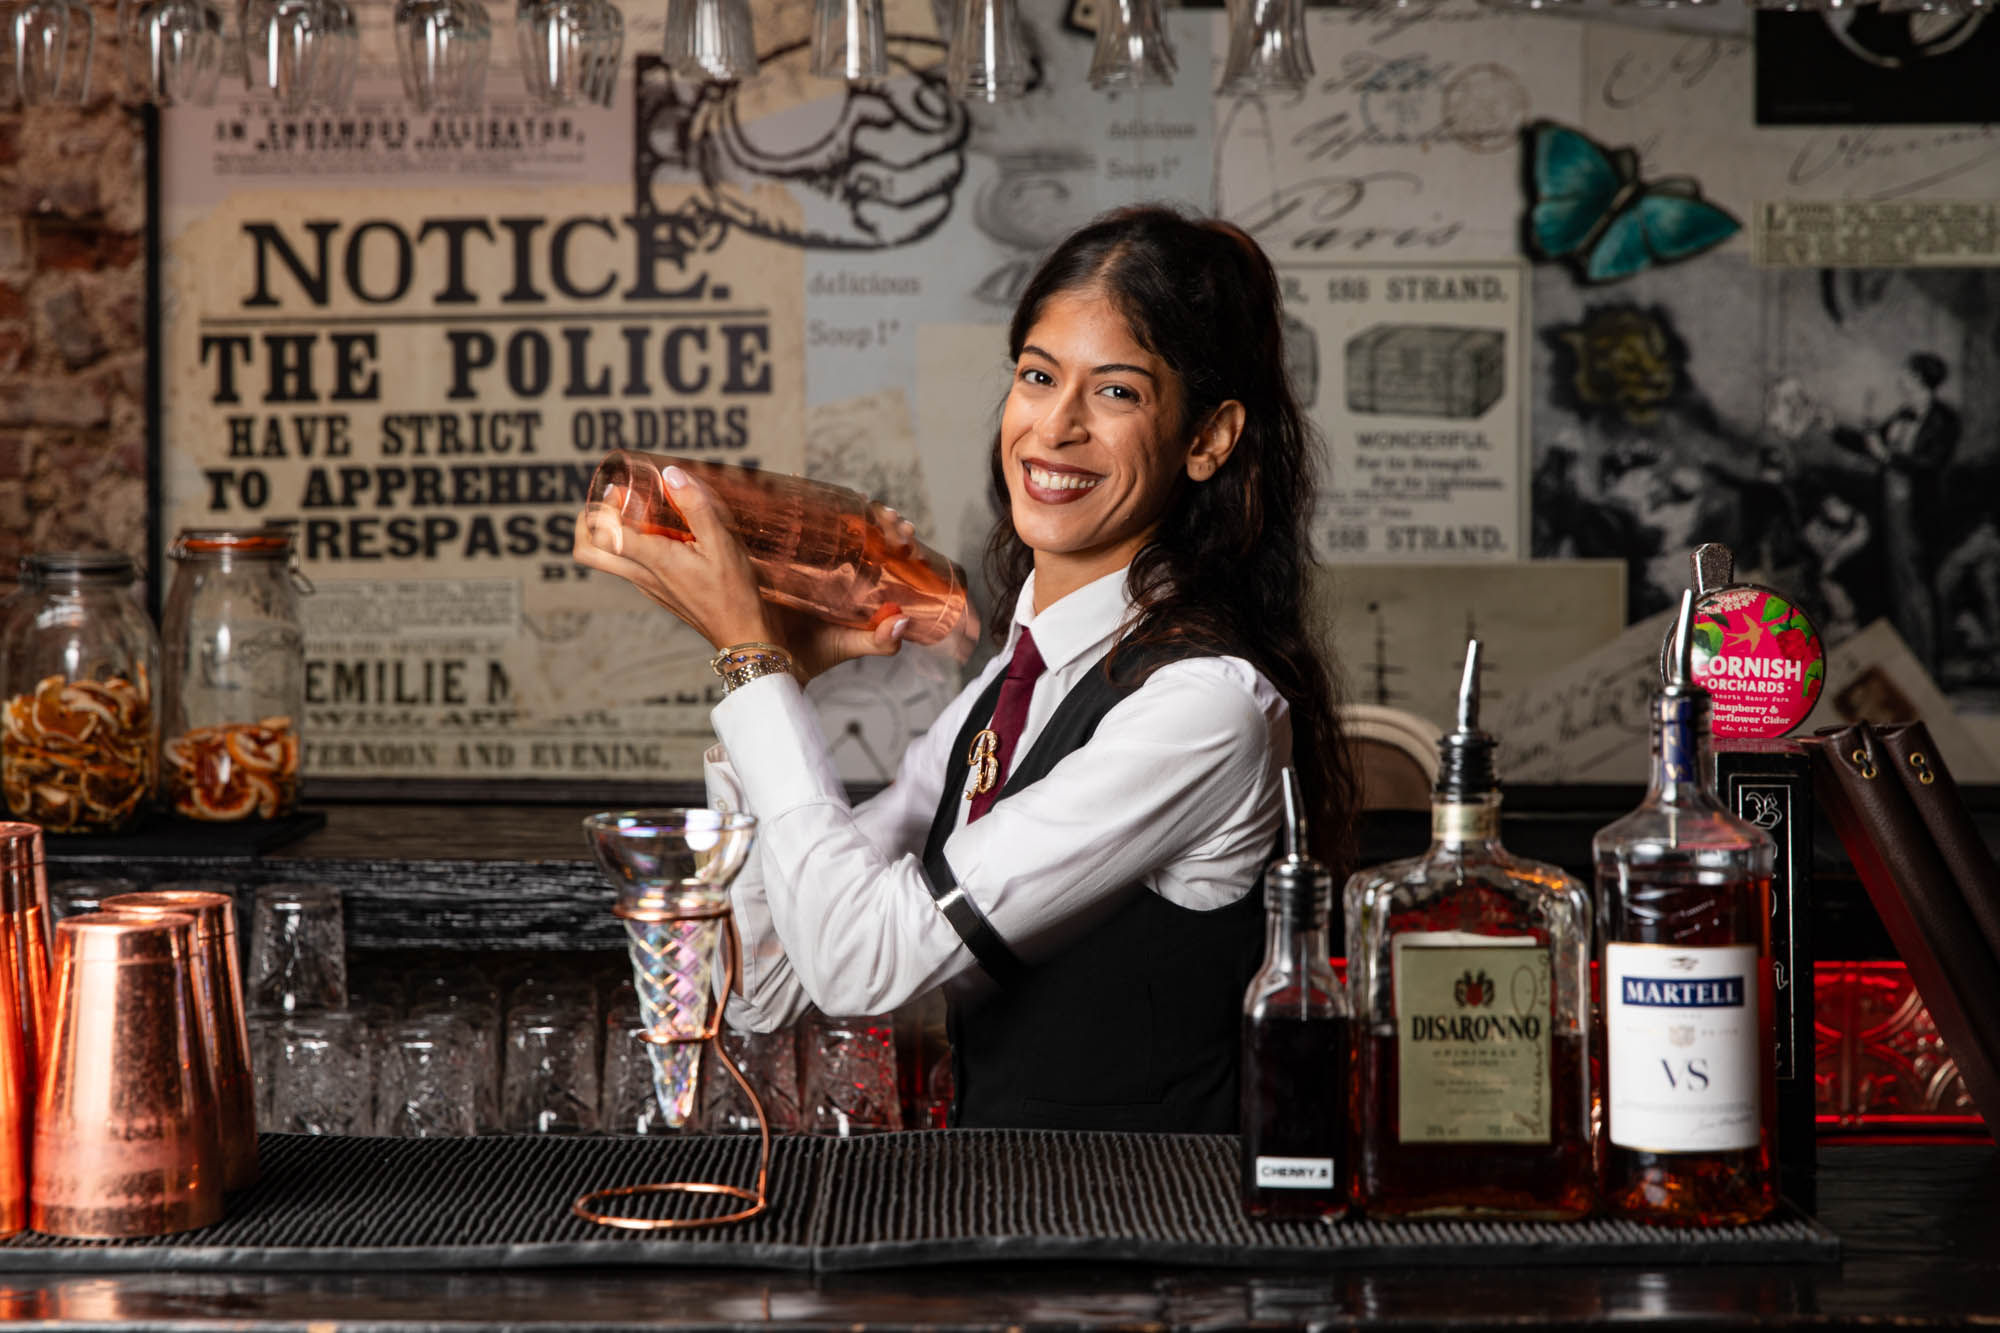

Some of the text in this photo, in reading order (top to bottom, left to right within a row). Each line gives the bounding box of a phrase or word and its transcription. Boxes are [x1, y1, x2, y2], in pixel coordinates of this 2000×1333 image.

[1108, 119, 1196, 140] delicious
[241, 215, 732, 306] NOTICE.
[806, 268, 923, 297] delicious
[1386, 275, 1510, 304] STRAND.
[200, 323, 773, 403] THE POLICE
[228, 407, 748, 458] HAVE STRICT ORDERS
[204, 463, 605, 512] TO APPREHEN
[1385, 524, 1511, 552] STRAND.
[541, 564, 591, 580] BY
[304, 660, 468, 704] EMILIE
[1693, 655, 1802, 682] CORNISH
[1707, 677, 1786, 694] ORCHARDS
[1711, 701, 1779, 716] Raspberry &
[1762, 715, 1791, 726] Cider
[302, 742, 438, 767] TERNOON
[456, 741, 516, 768] AND
[1626, 981, 1738, 1004] MARTELL
[1412, 1014, 1541, 1043] DISARONNO
[1660, 1058, 1710, 1091] VS
